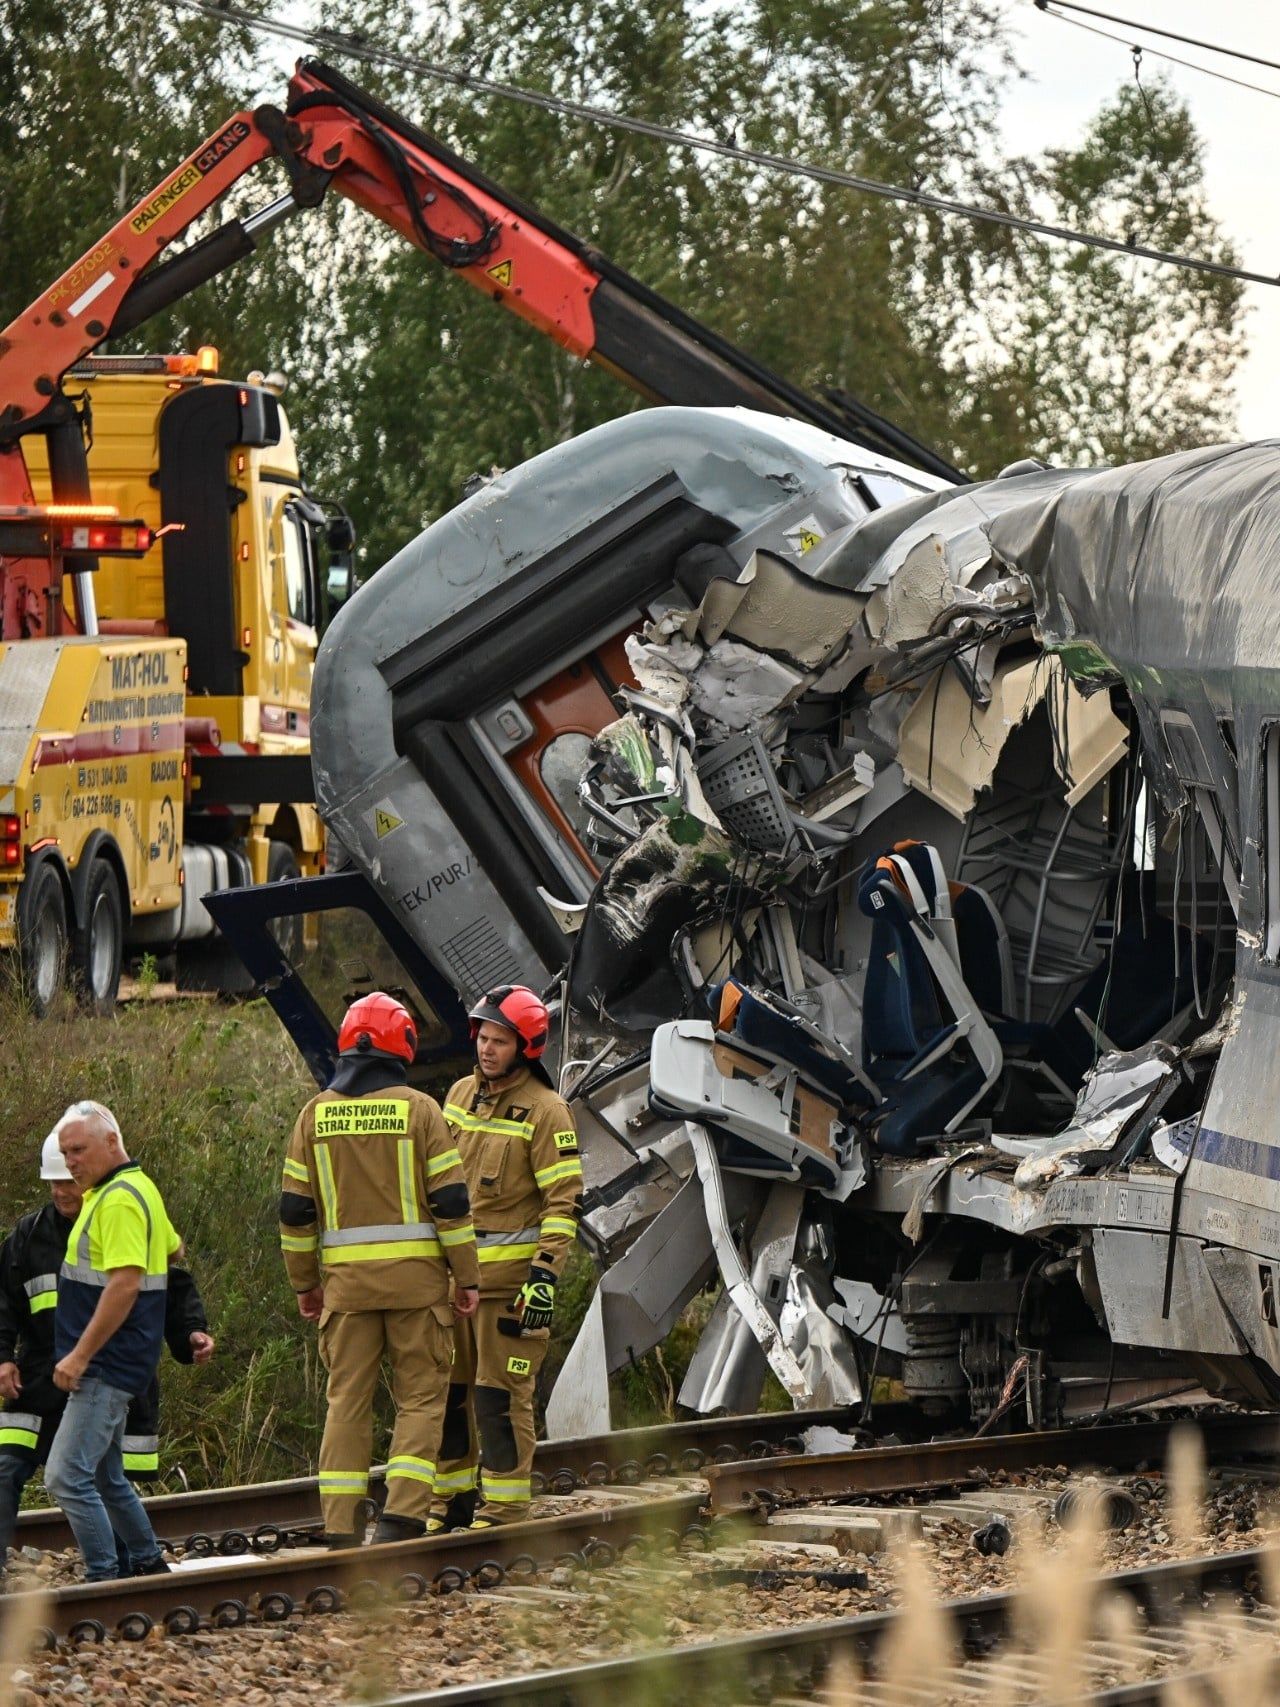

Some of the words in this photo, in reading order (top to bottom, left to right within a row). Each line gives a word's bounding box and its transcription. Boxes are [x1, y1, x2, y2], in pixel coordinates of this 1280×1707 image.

[132, 167, 200, 232] PALFINGER
[197, 122, 248, 170] CRANE
[49, 287, 66, 305] PK
[112, 652, 169, 689] MAT-HOL
[151, 760, 178, 783] RADOM
[325, 1102, 397, 1118] PAŃSTWOWA
[558, 1133, 575, 1145] PSP
[511, 1359, 528, 1372] PSP
